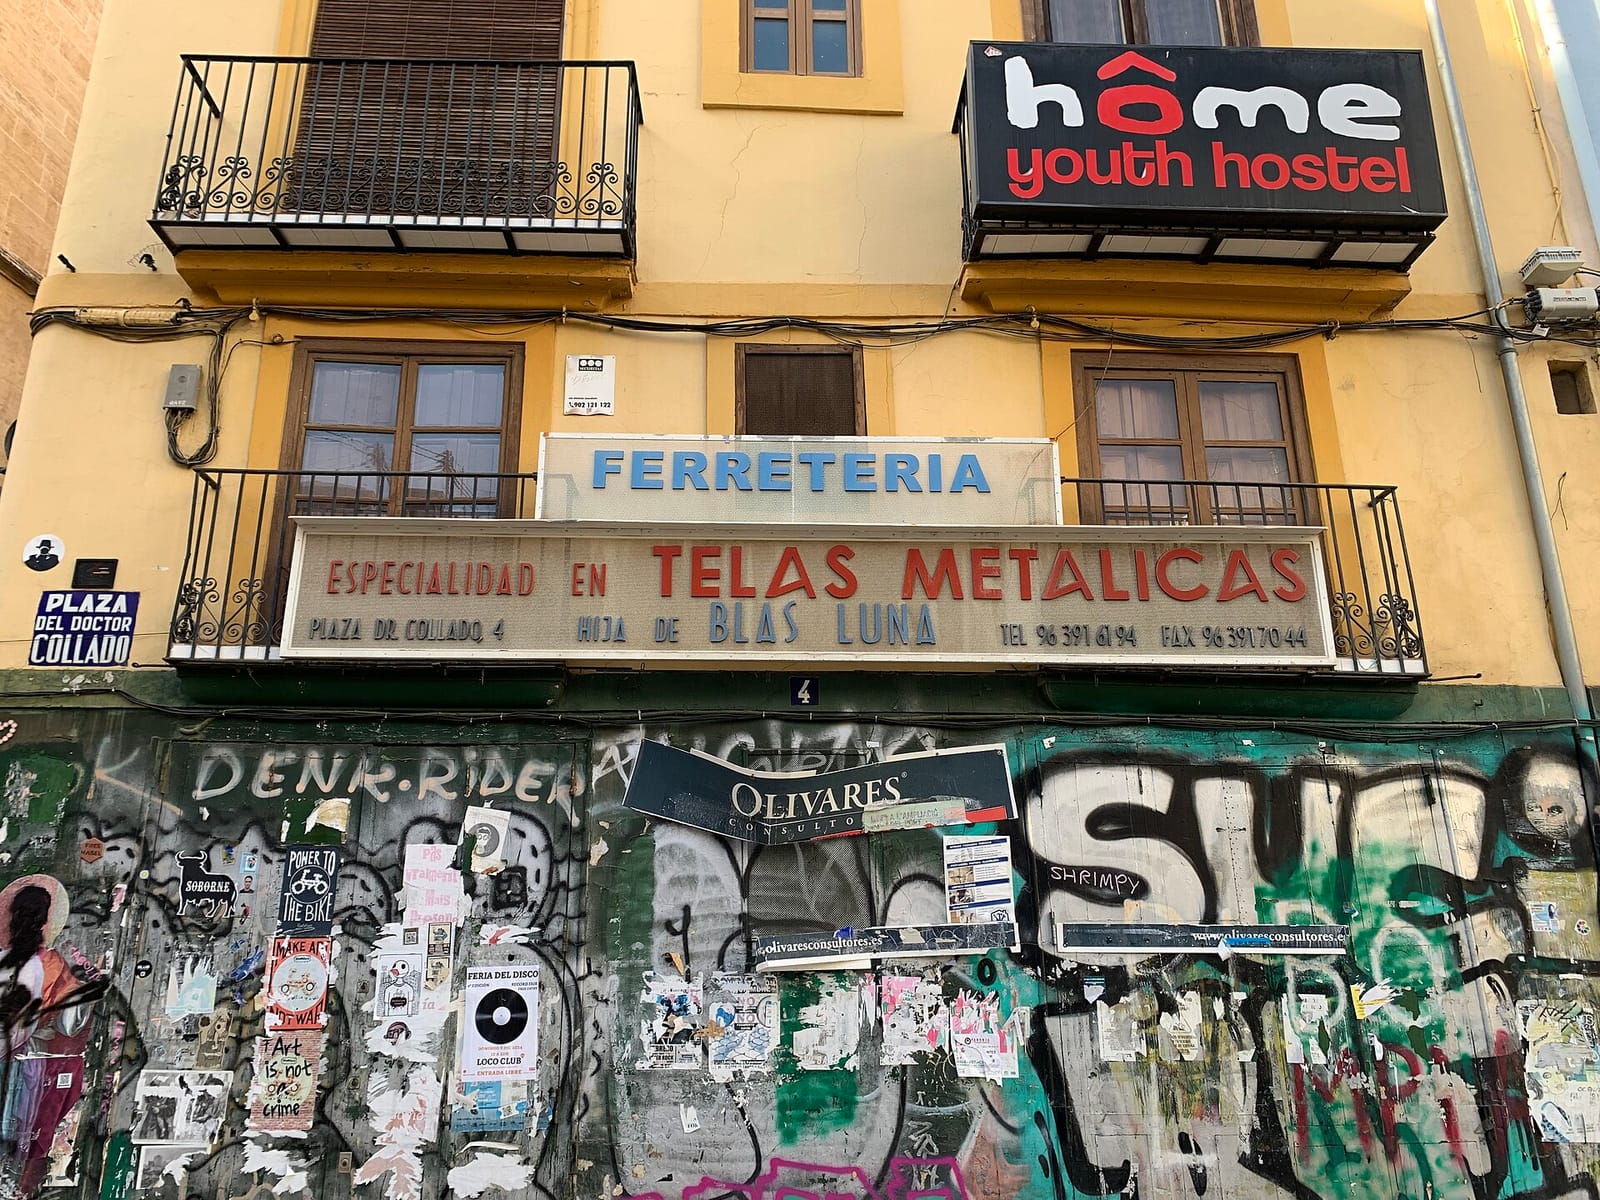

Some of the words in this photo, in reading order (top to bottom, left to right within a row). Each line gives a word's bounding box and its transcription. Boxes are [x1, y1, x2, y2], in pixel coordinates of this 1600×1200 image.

[1006, 141, 1194, 199] youth
[1211, 141, 1412, 193] hostel
[592, 449, 991, 494] FERRETERIA
[327, 559, 535, 597] ESPECIALIDAD
[571, 562, 607, 597] EN
[652, 543, 859, 600] TELAS
[901, 546, 1308, 603] METALICAS
[45, 593, 128, 613] PLAZA
[34, 615, 64, 631] DEL
[70, 616, 133, 632] DOCTOR
[308, 617, 362, 642] PLAZA
[493, 618, 505, 642] 4
[577, 615, 627, 643] HIJA
[654, 616, 680, 644] DE
[709, 600, 800, 644] BLAS
[837, 602, 937, 646] LUNA
[1161, 624, 1196, 648] FAX
[30, 633, 130, 664] COLLADO
[796, 680, 811, 705] 4
[731, 776, 901, 820] OLIVARES
[288, 850, 321, 877] POWER
[323, 850, 336, 876] TO
[185, 880, 230, 893] SOBORNE
[1050, 866, 1140, 895] SHRIMPY
[283, 893, 303, 922] THE
[304, 892, 333, 922] BIKE
[467, 972, 493, 980] FERIA
[494, 971, 512, 979] DEL
[512, 970, 539, 979] DISCO
[265, 1060, 278, 1079] is
[285, 1059, 313, 1077] not
[476, 1058, 499, 1066] LOCO
[499, 1056, 522, 1065] CLUB
[262, 1098, 301, 1118] crime
